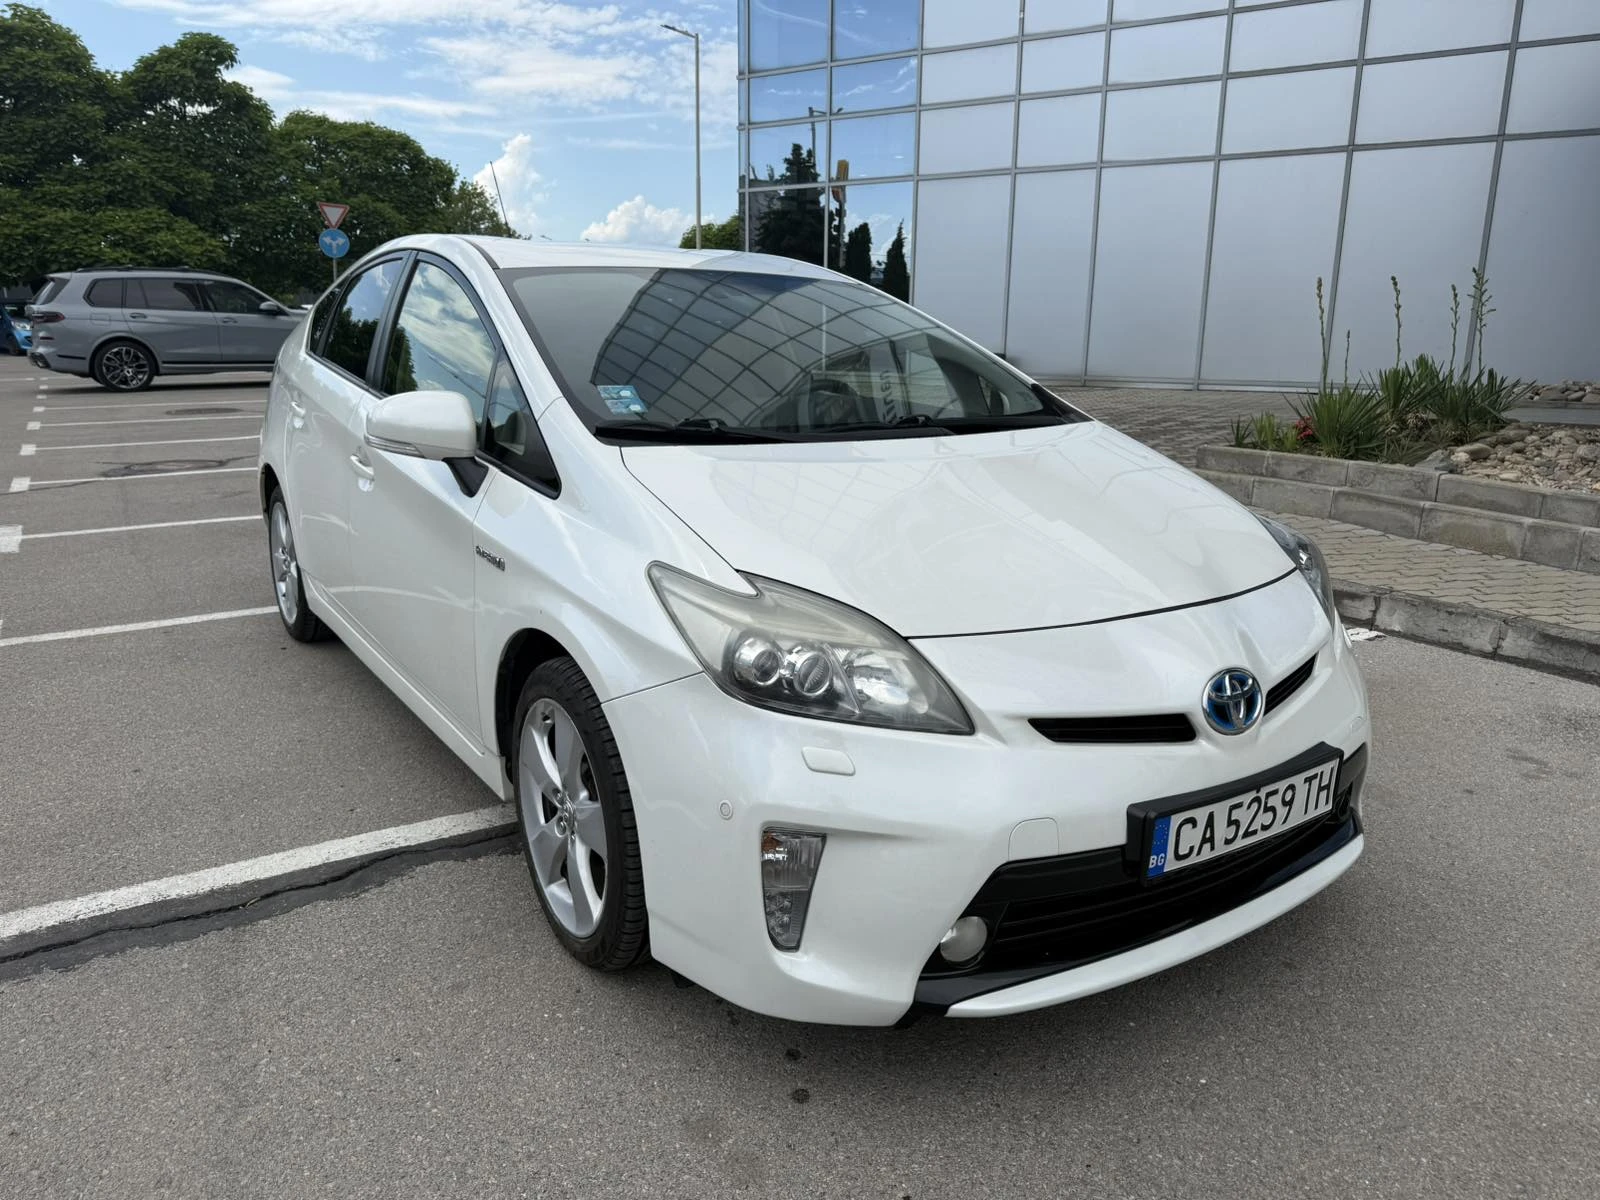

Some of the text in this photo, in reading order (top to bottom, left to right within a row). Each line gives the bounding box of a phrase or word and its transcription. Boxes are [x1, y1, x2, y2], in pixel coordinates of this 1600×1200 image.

[1173, 766, 1335, 862] CA 5259 TH
[1149, 853, 1165, 868] BG
